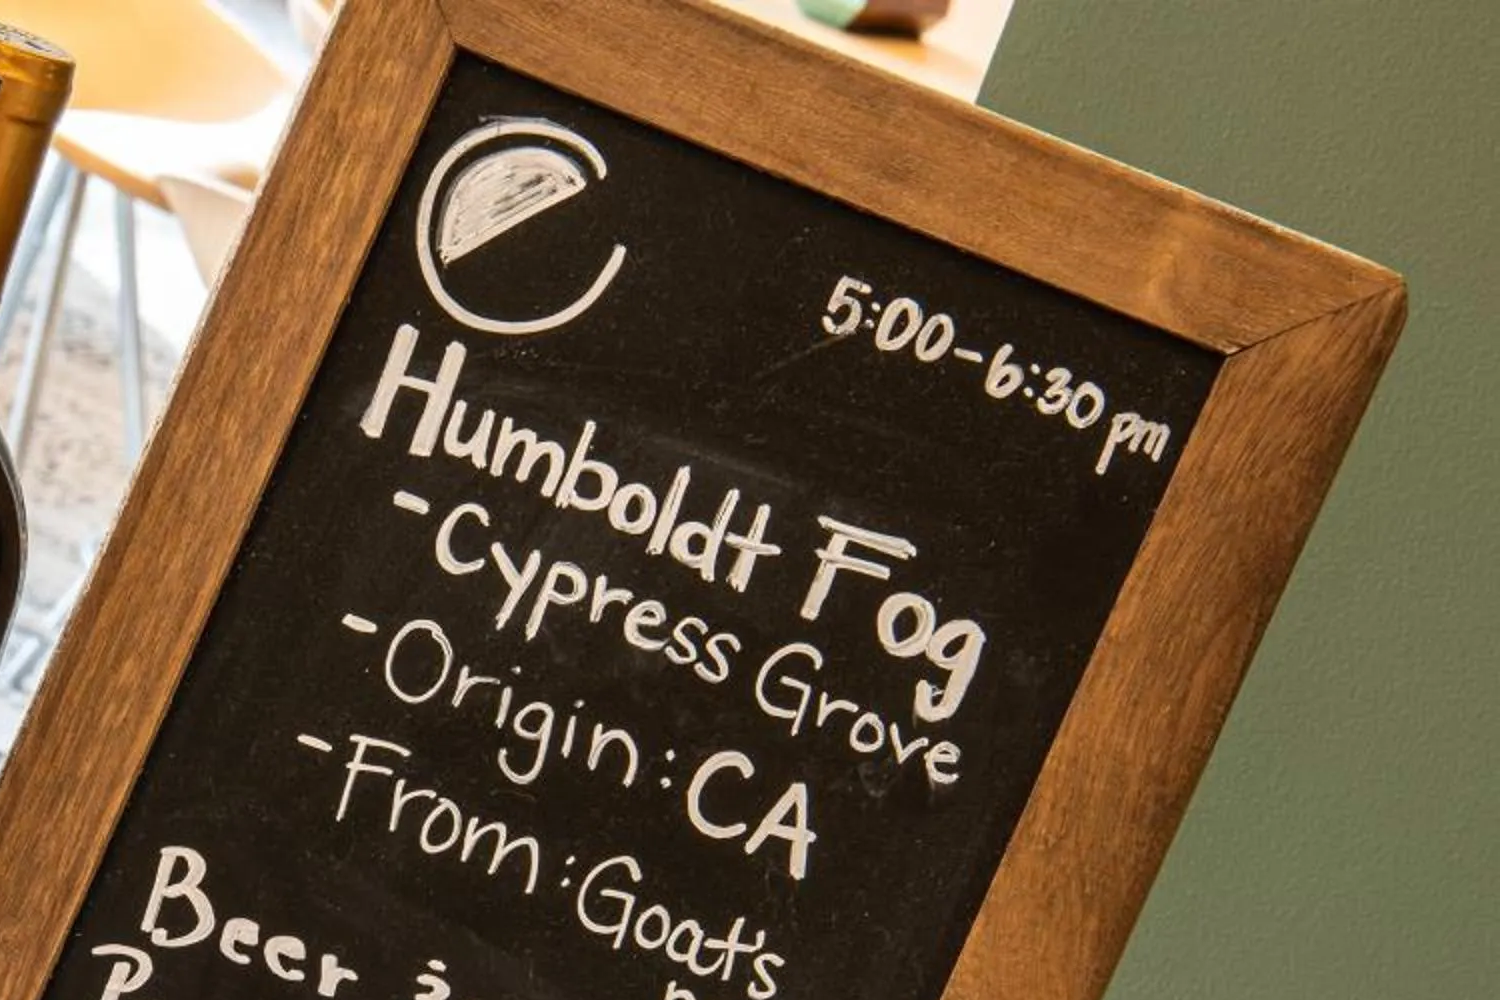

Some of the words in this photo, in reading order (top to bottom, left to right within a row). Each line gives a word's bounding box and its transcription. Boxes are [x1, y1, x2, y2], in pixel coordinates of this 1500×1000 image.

[1095, 412, 1171, 475] pm
[359, 323, 783, 593] Humboldt
[800, 515, 987, 723] Fog
[755, 642, 962, 785] Grove
[686, 750, 817, 881] CA
[140, 845, 360, 998] Beer
